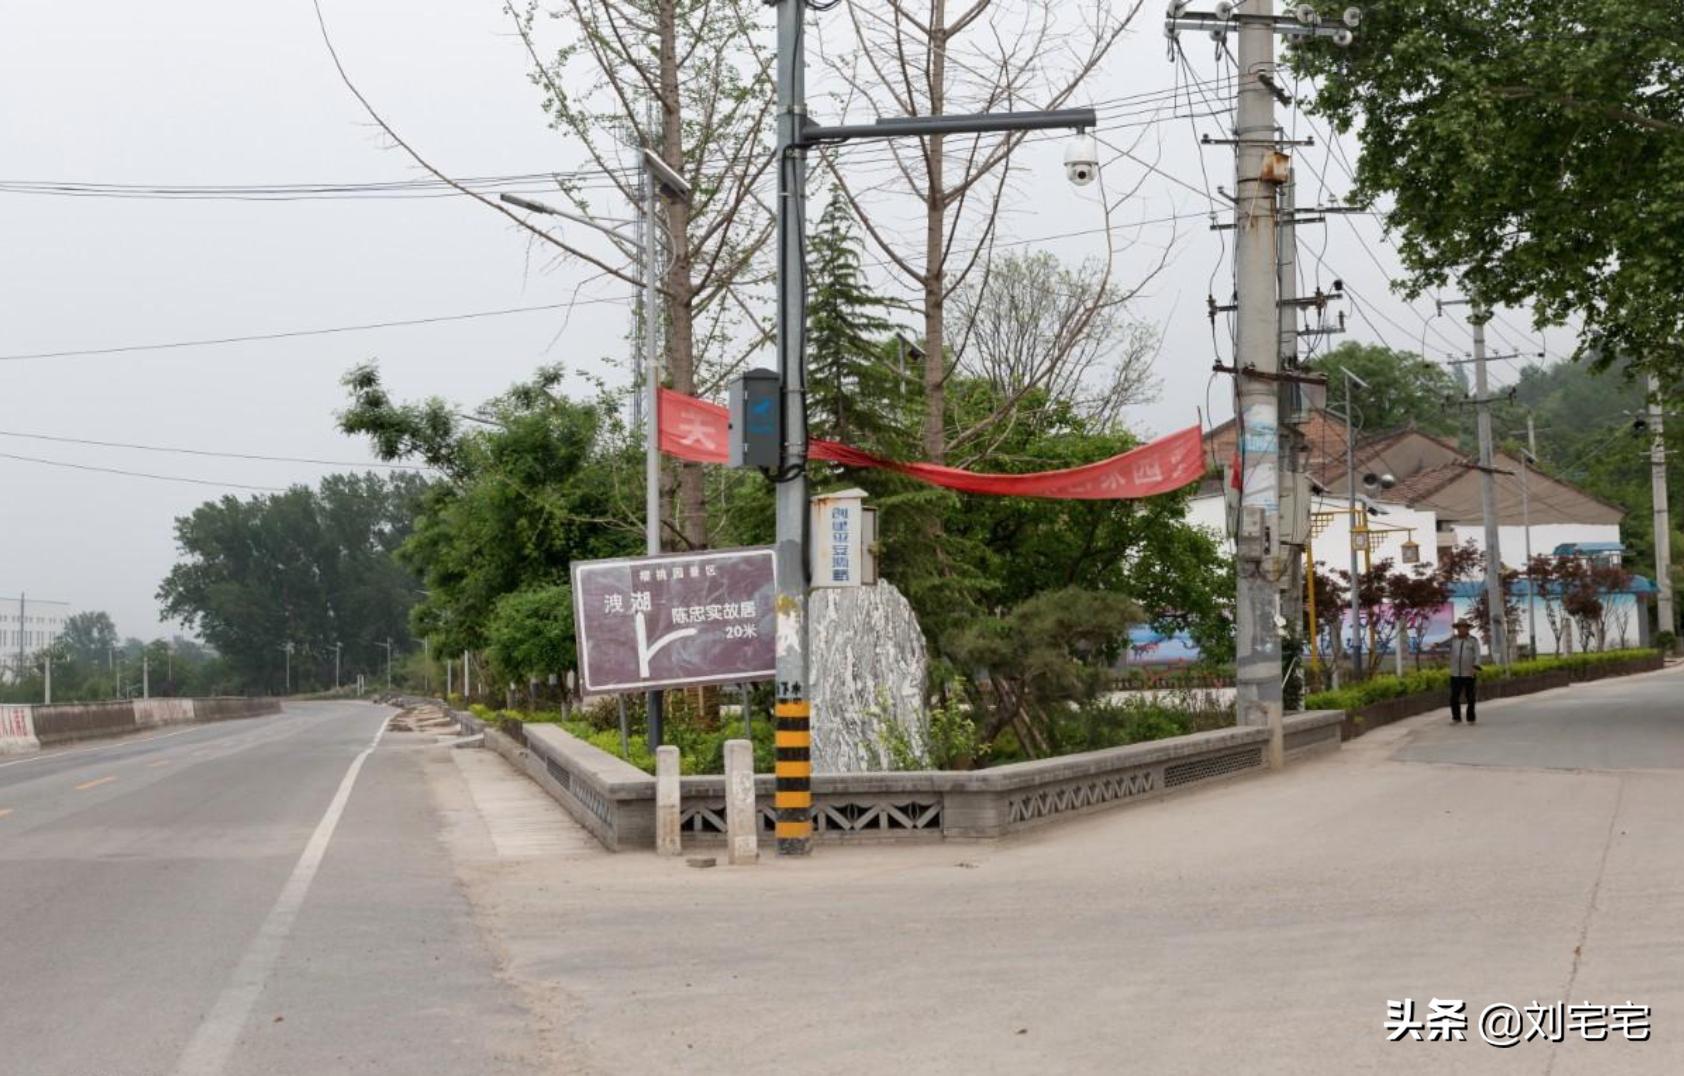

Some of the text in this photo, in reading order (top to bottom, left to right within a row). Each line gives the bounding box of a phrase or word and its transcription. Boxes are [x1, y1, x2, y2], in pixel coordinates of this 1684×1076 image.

[672, 600, 755, 624] 陈忠实故居
[726, 624, 757, 639] 20米
